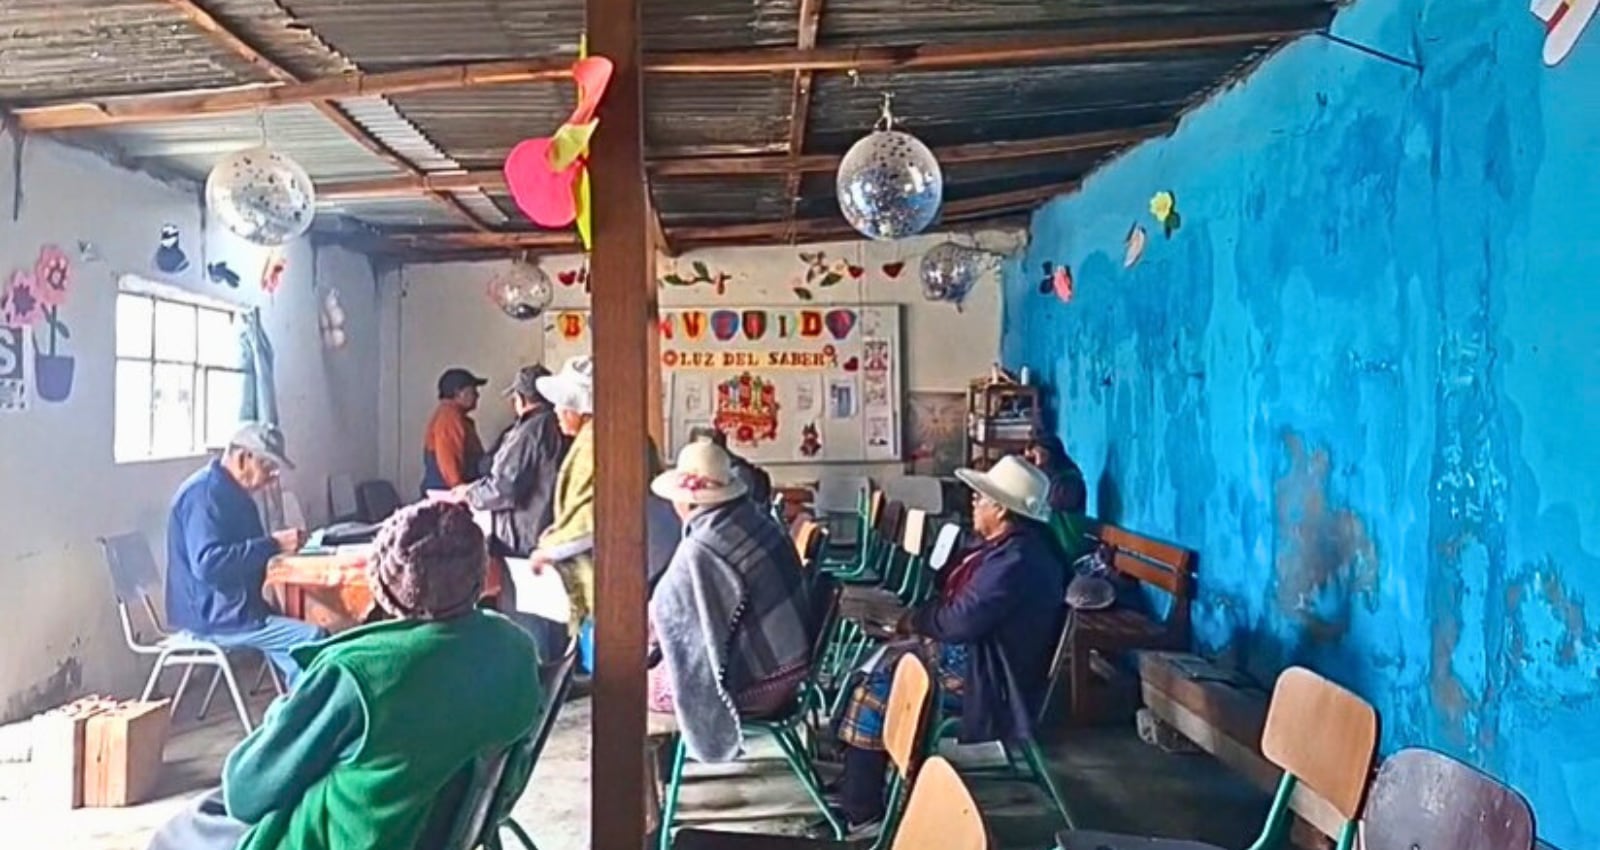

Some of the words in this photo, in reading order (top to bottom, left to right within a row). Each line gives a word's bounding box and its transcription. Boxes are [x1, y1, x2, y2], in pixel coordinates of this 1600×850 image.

[680, 351, 715, 366] LUZ
[723, 351, 759, 366] DEL
[768, 351, 825, 366] SABER
